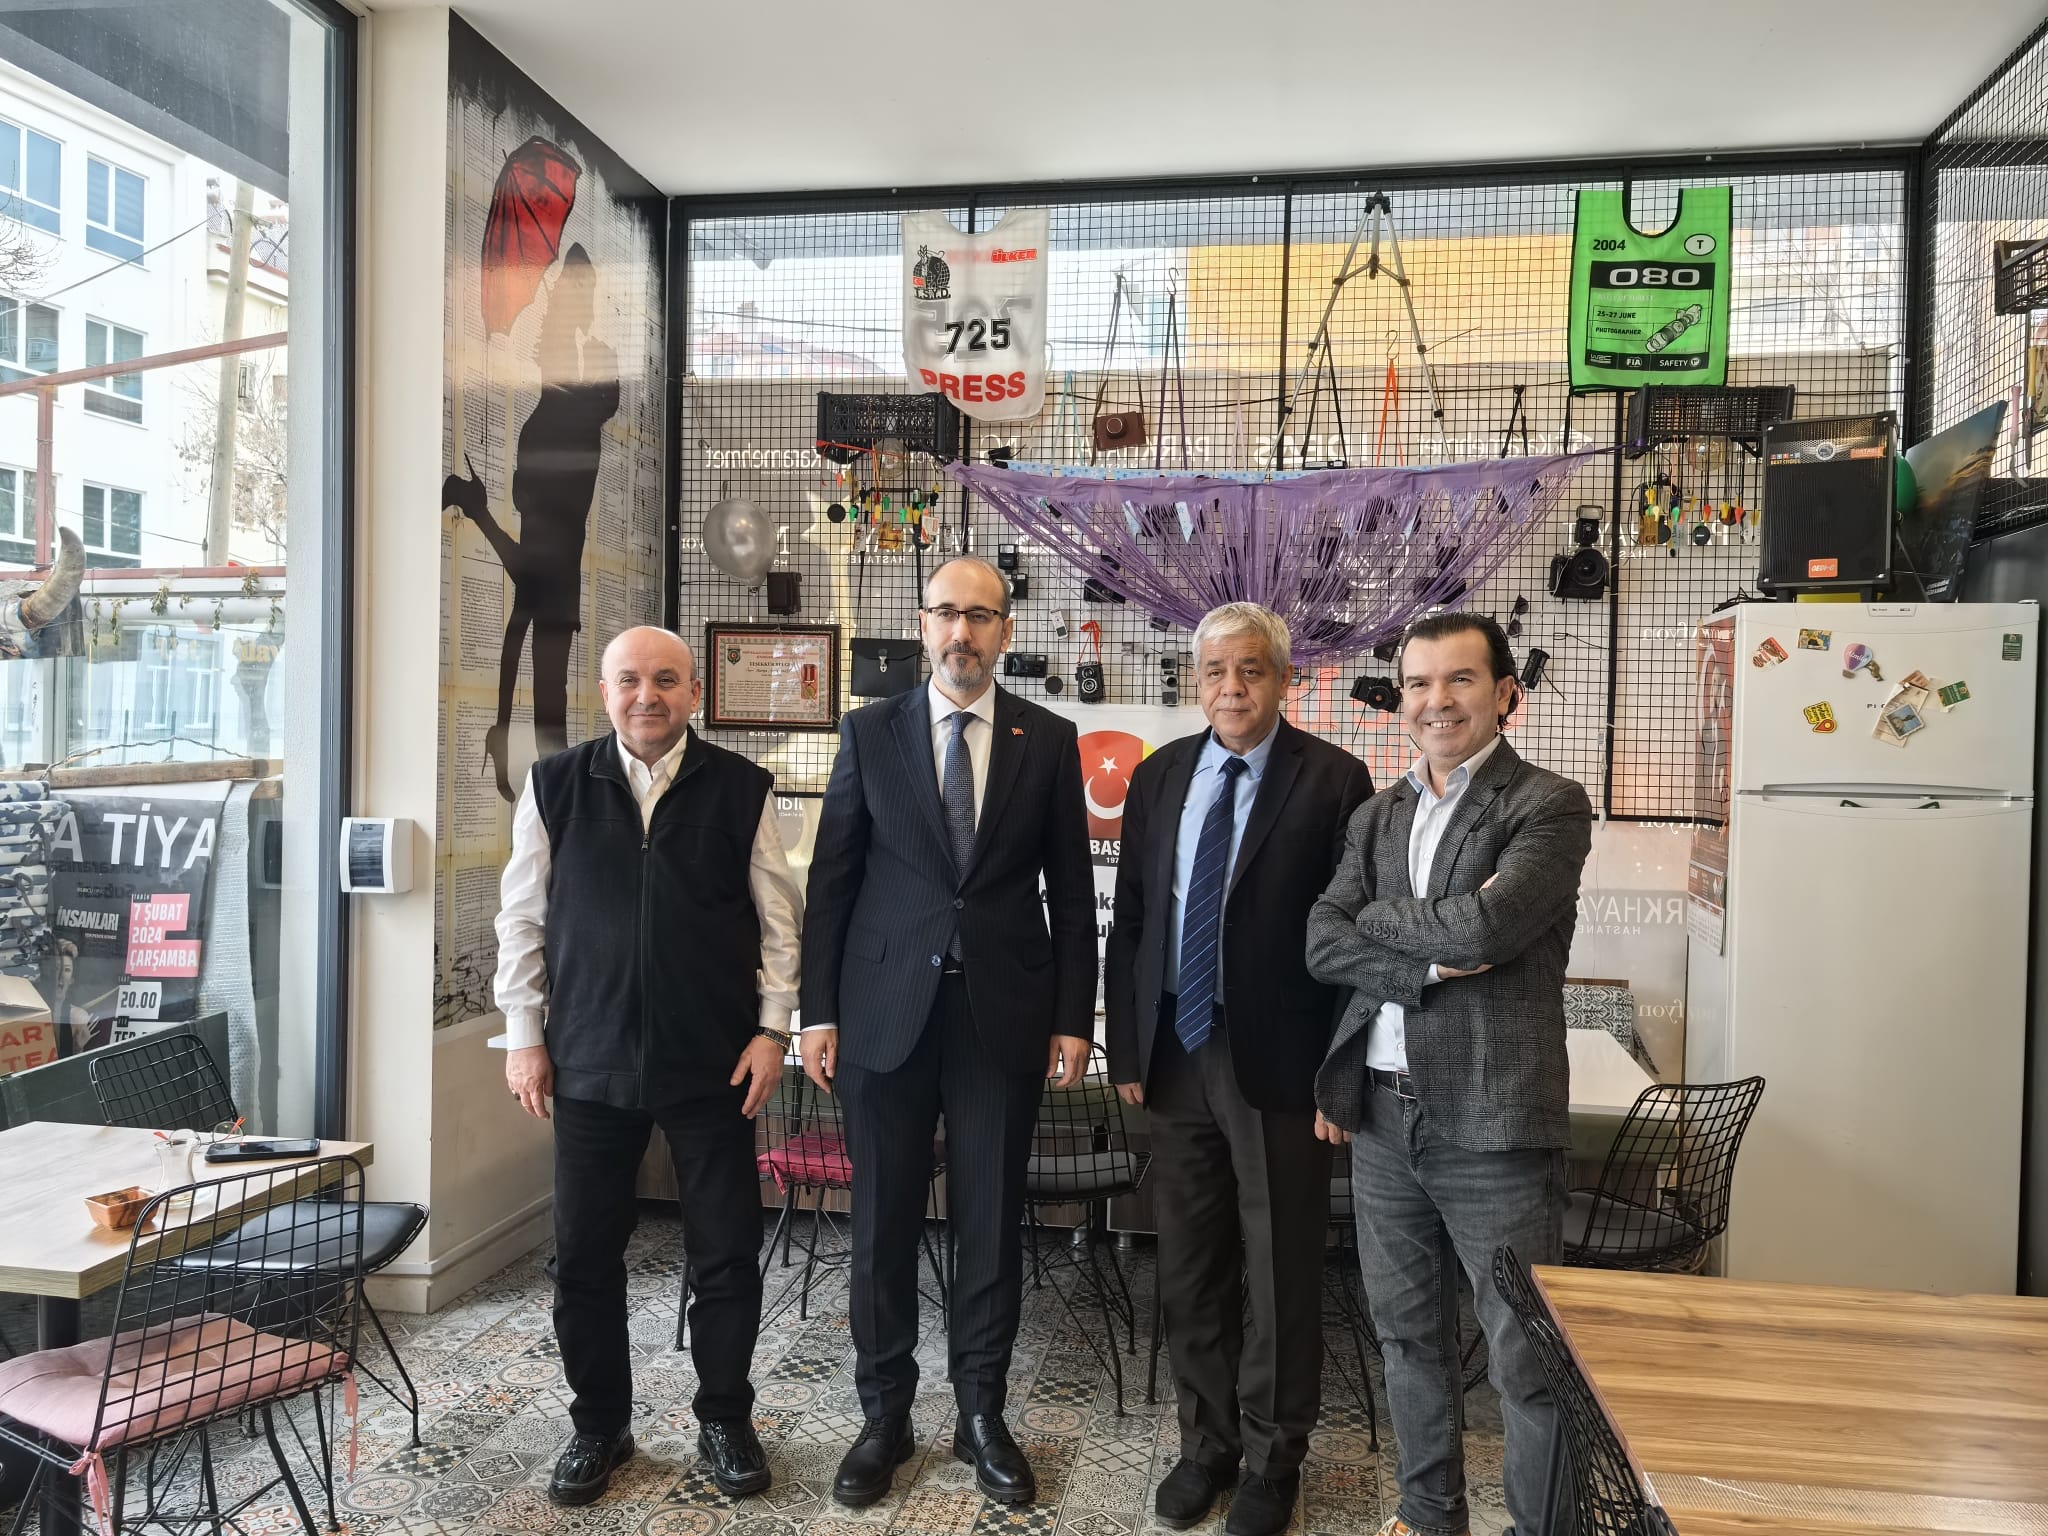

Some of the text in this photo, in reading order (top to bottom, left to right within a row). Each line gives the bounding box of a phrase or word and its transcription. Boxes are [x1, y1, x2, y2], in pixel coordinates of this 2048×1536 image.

[1592, 239, 1626, 251] 2004
[1696, 239, 1704, 249] T
[1609, 267, 1700, 287] 080
[1597, 311, 1636, 319] 25-27 JUNE
[945, 317, 1011, 355] 725
[1595, 327, 1642, 335] PHOTOGRAPHER
[1626, 358, 1641, 367] FIA
[1659, 359, 1688, 367] SAFETY
[919, 368, 1026, 403] PRESS
[56, 904, 120, 931] İNSANLARI
[134, 903, 183, 926] 7 ŞUBAT
[131, 926, 163, 944] 2024
[129, 949, 198, 972] ÇARŞAMBA
[120, 991, 157, 1009] 20.00
[0, 1022, 53, 1048] AR
